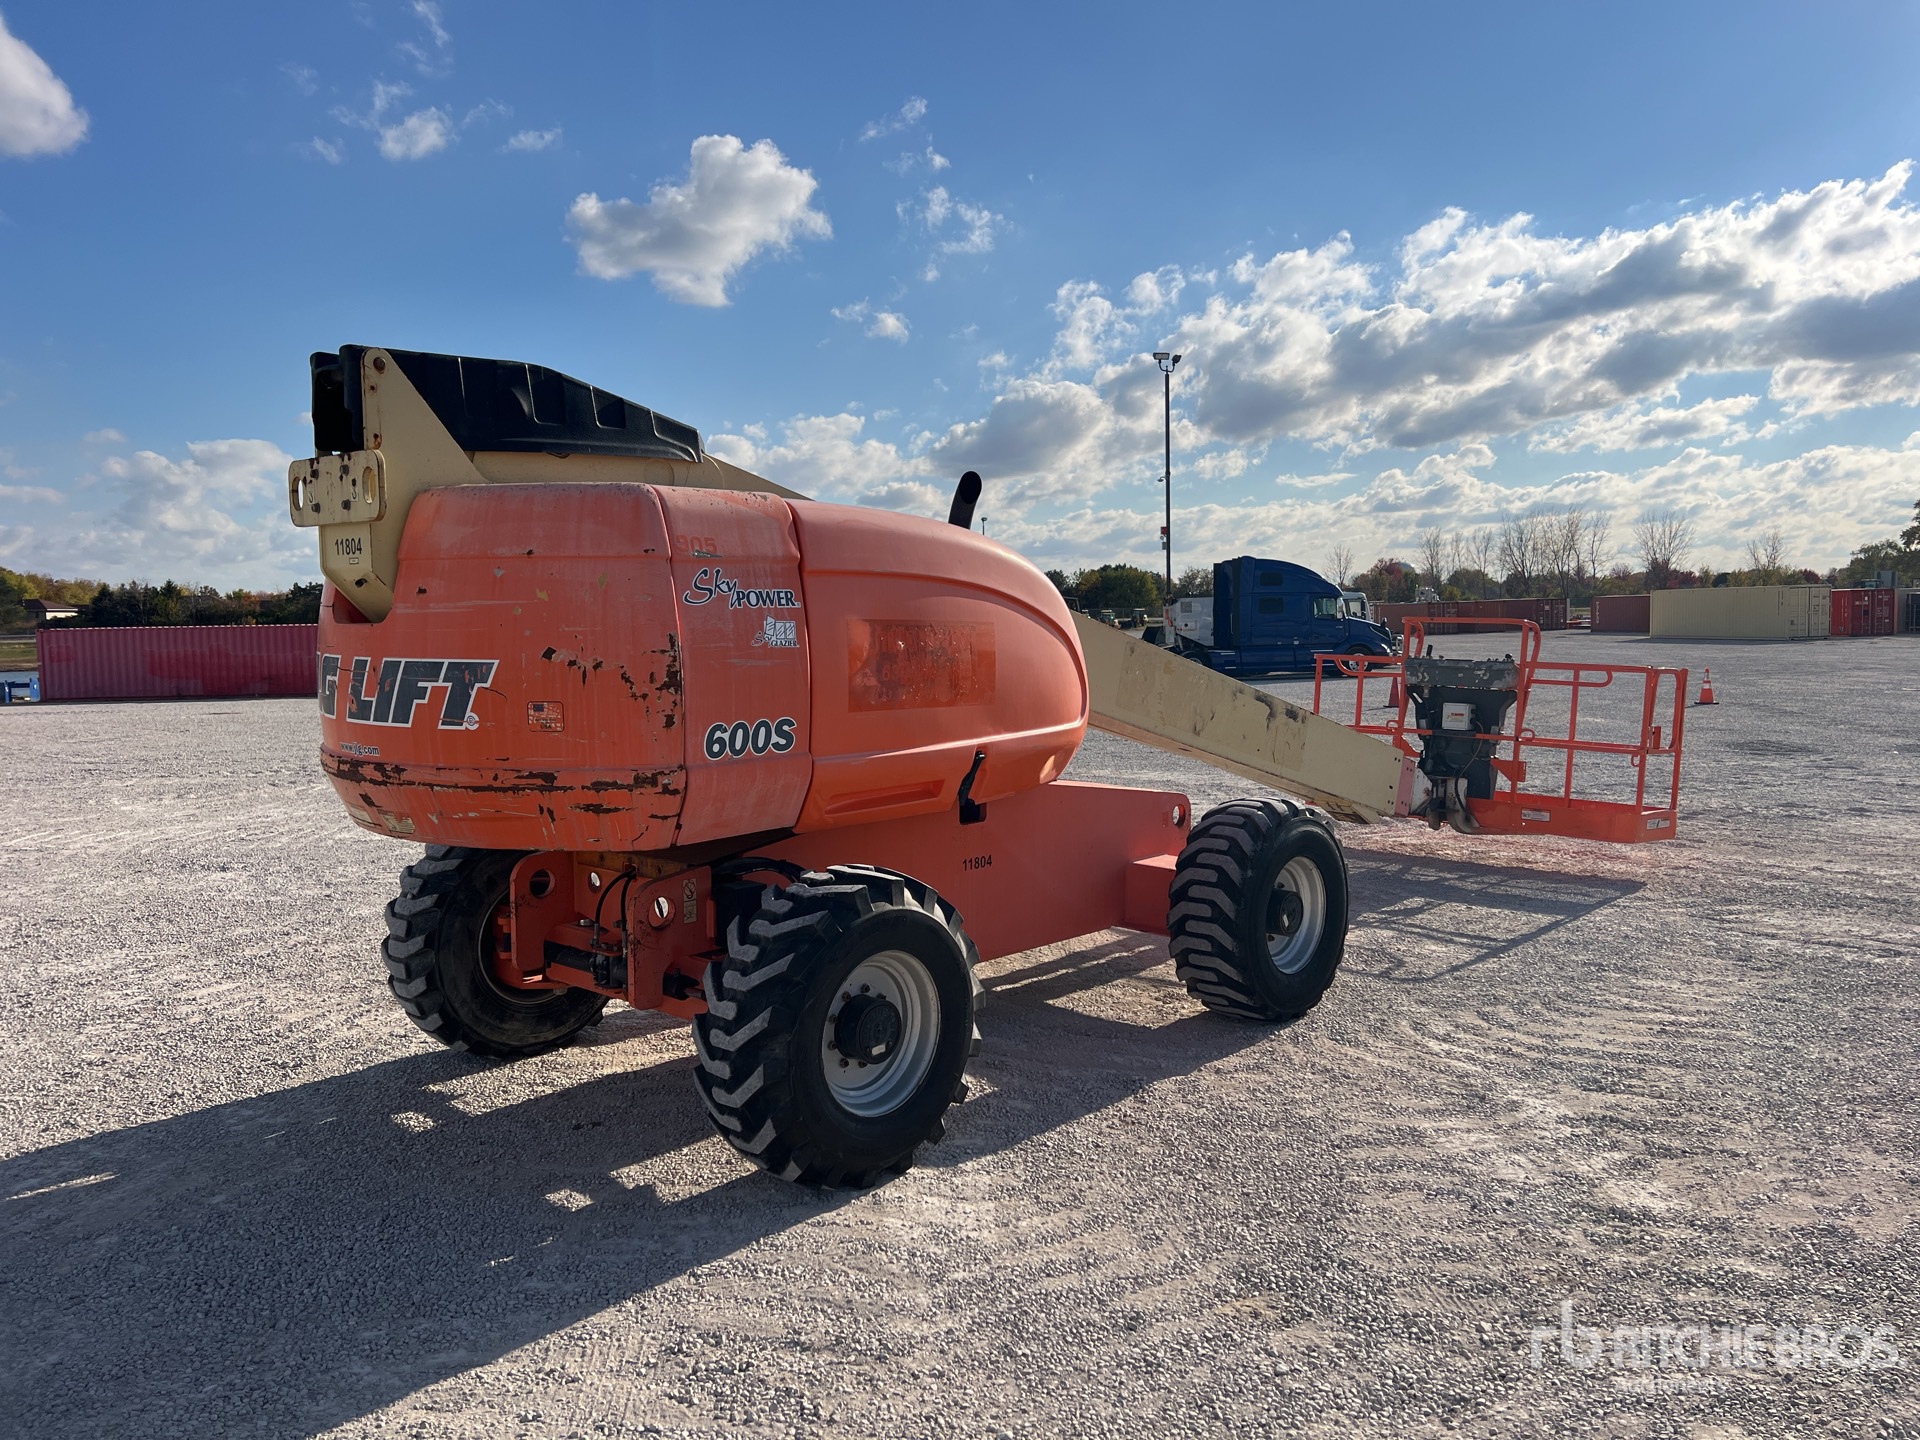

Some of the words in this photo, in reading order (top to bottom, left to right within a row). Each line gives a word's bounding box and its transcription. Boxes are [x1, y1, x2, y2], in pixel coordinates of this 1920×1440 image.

[334, 538, 363, 556] 11804
[348, 657, 498, 729] LIFT
[704, 717, 797, 760] 600S
[962, 854, 993, 871] 11804
